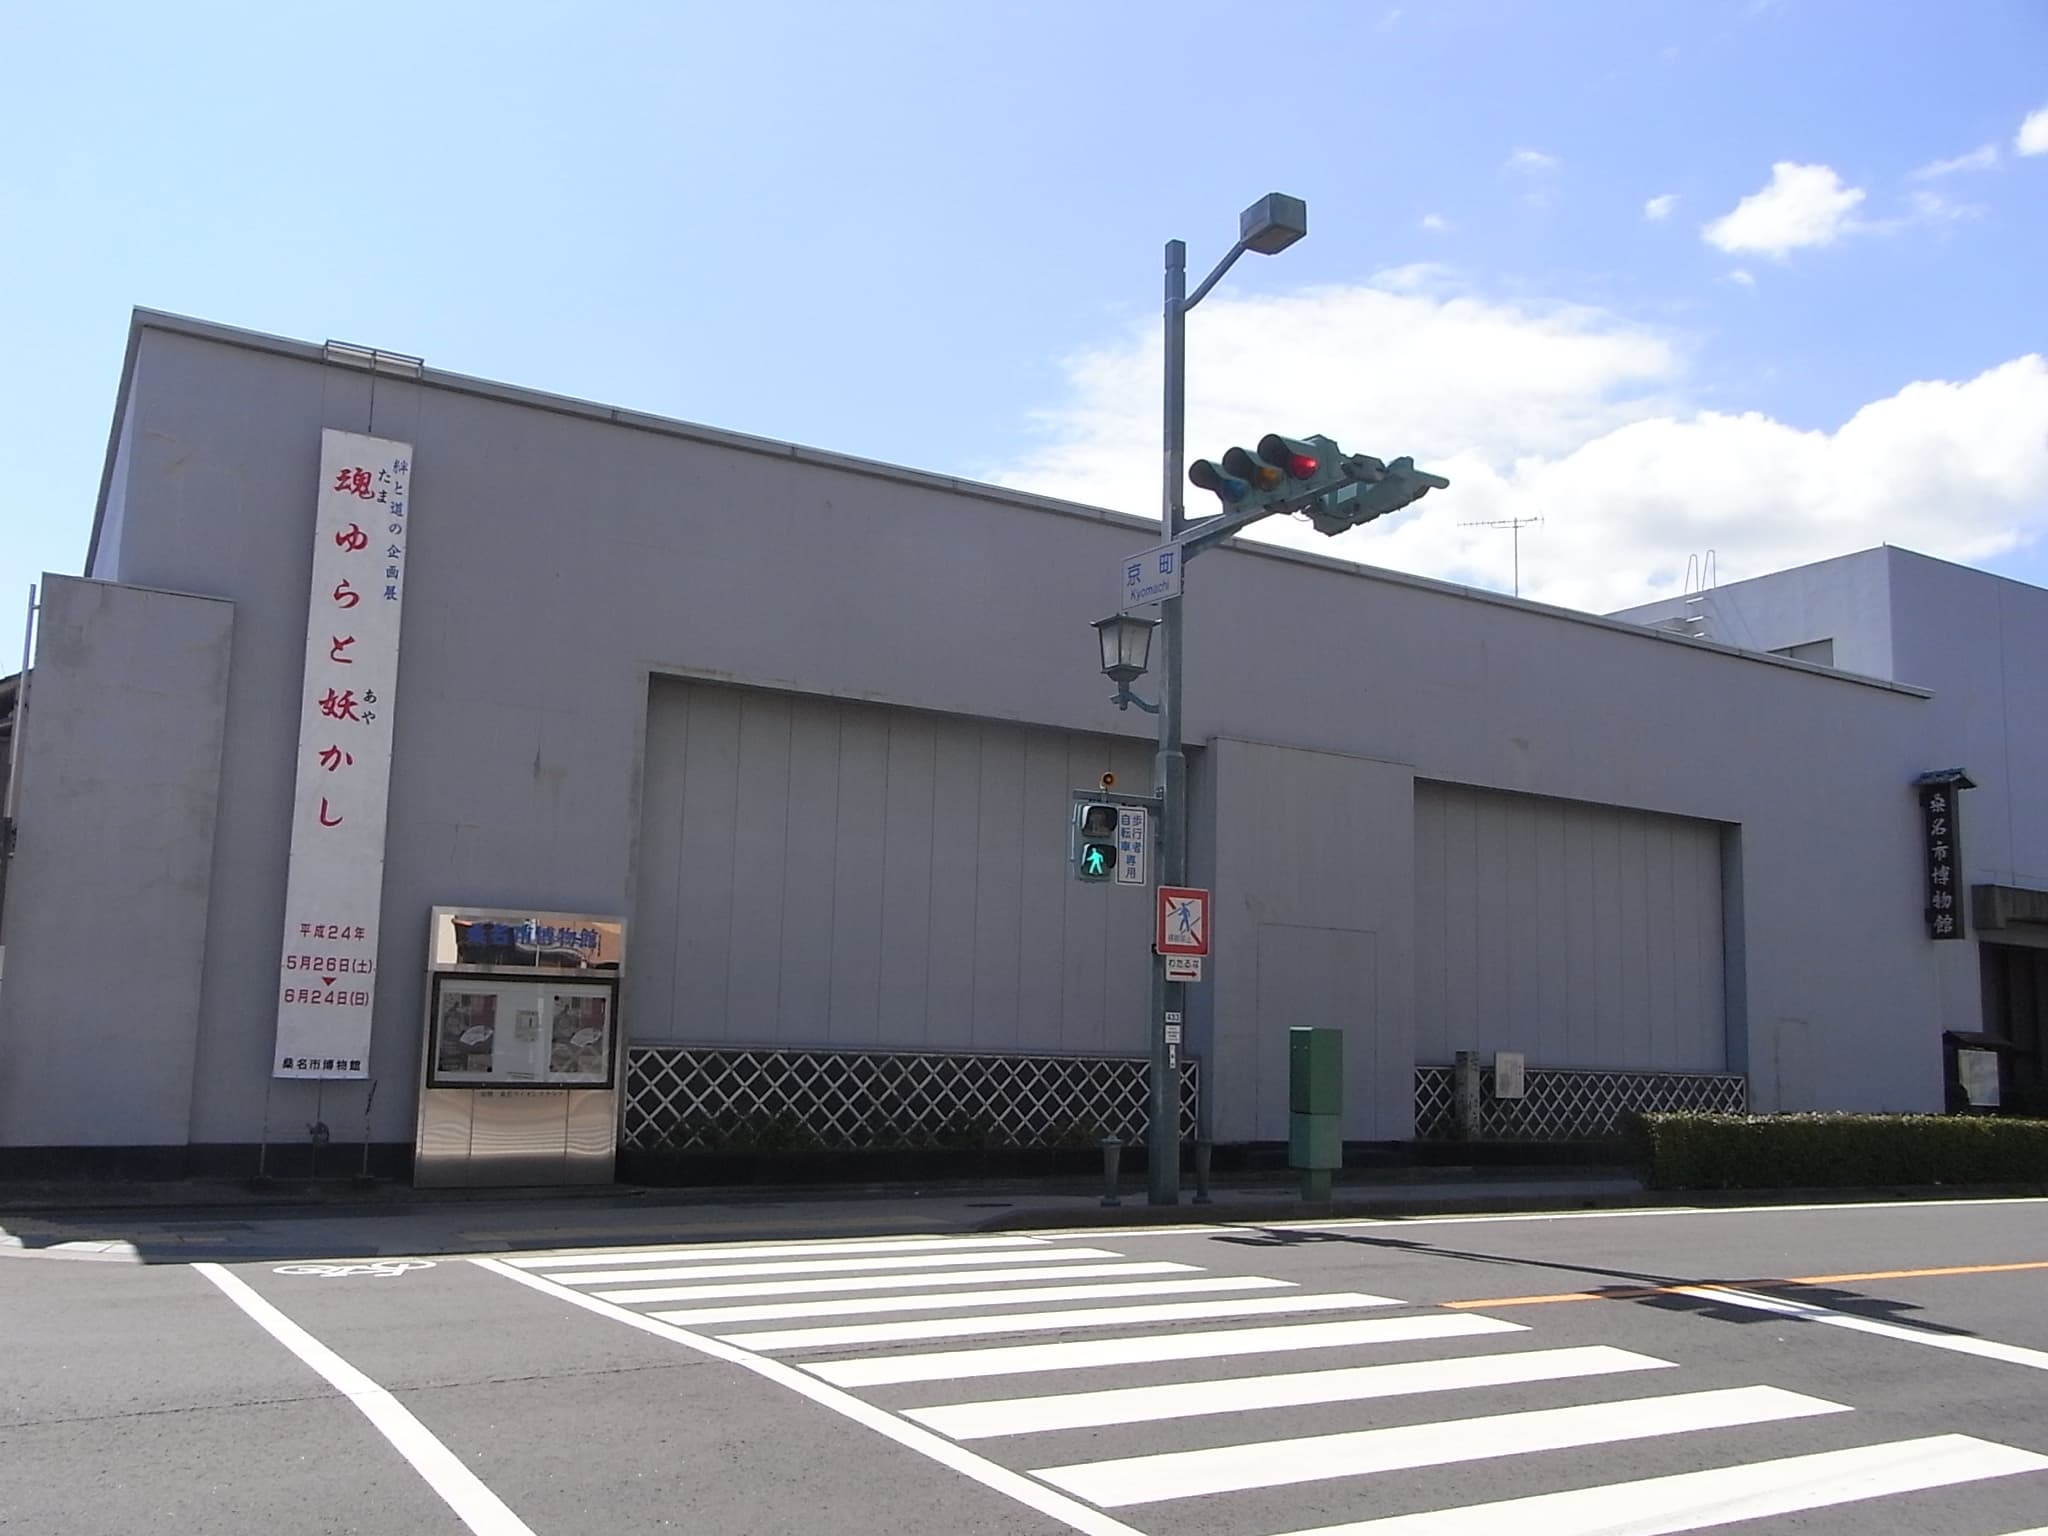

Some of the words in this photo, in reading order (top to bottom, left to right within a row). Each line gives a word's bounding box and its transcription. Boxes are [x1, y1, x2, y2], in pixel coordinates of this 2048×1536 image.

[376, 468, 391, 503] たま
[1127, 552, 1174, 587] 京町
[318, 467, 375, 827] 魂ゆらと妖かし
[362, 689, 377, 725] あや
[1930, 793, 1953, 935] 桑名市博物館
[300, 923, 366, 941] 平成24年
[282, 1057, 361, 1072] 桑名市博物館
